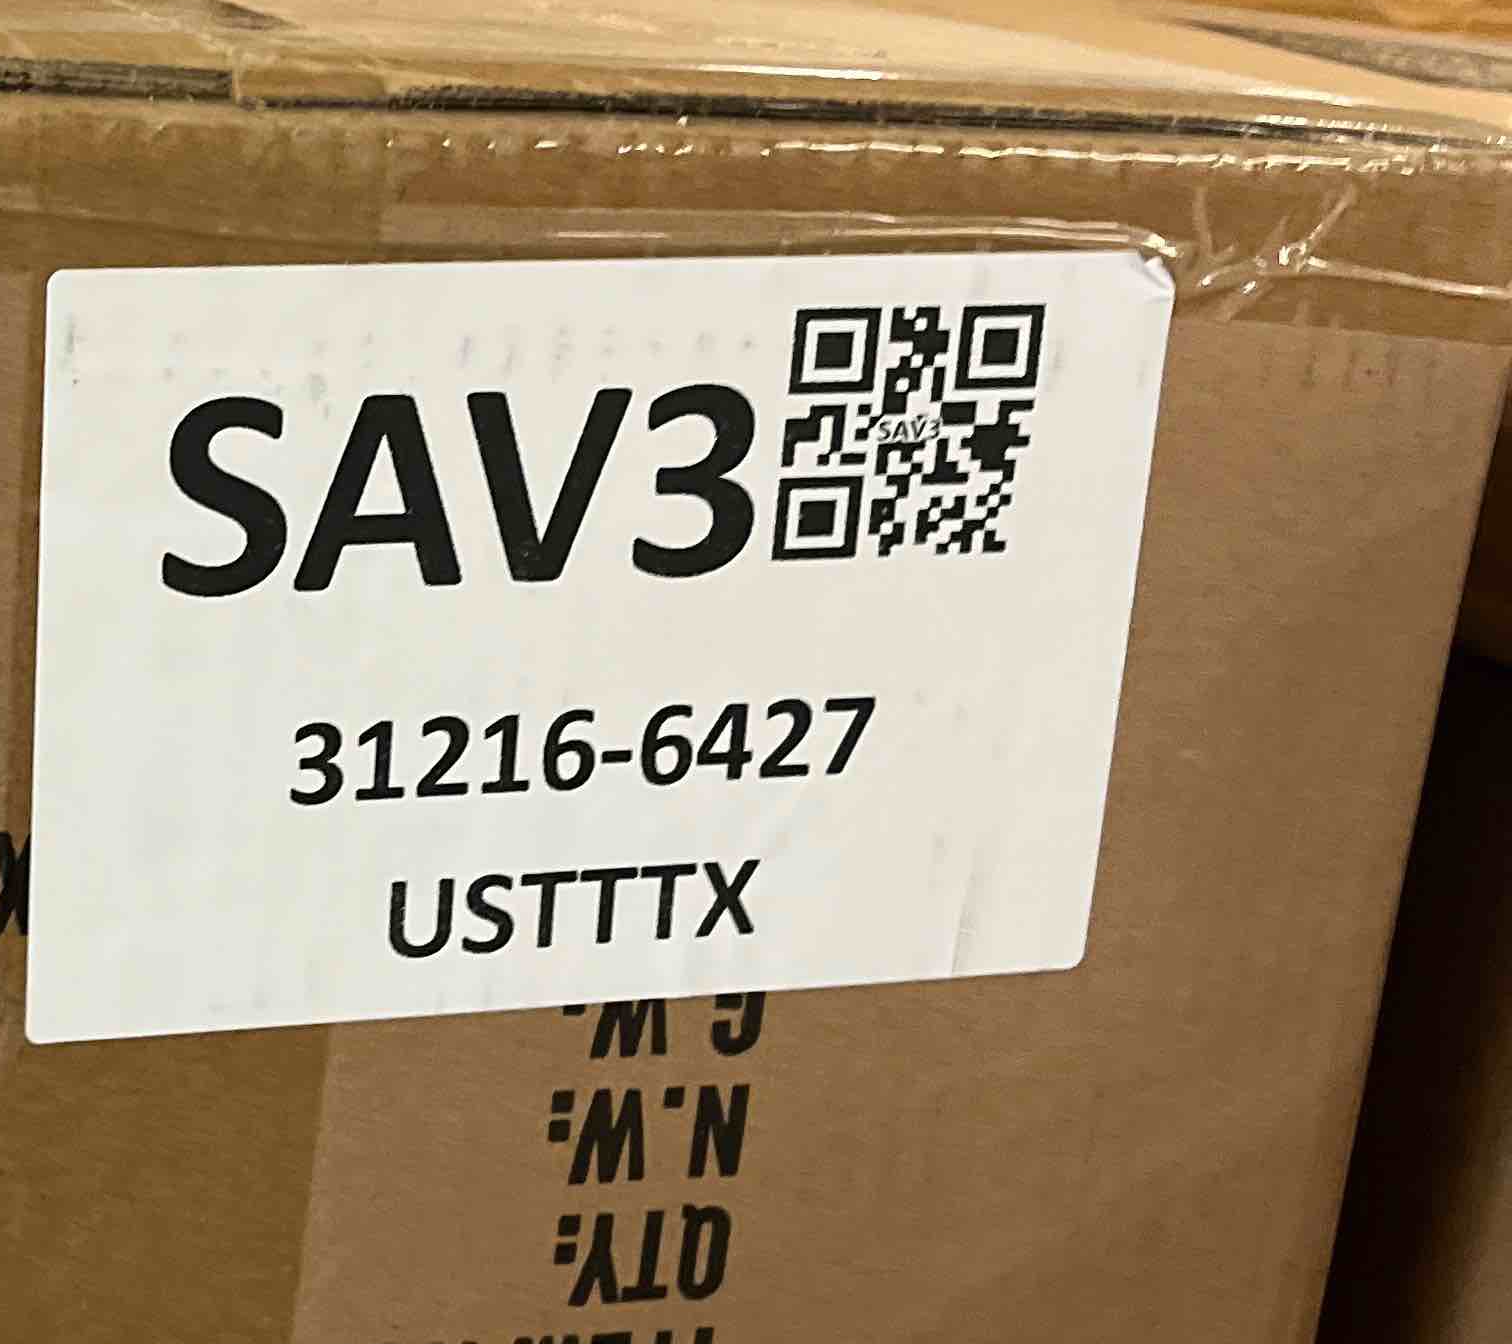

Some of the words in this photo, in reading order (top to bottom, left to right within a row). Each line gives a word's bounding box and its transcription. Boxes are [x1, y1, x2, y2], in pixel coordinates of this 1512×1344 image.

[877, 418, 939, 441] SAV3
[160, 382, 758, 598] SAV3
[289, 694, 876, 808] 31216-6427
[390, 858, 762, 960] USTTTX
[548, 1083, 750, 1186] N.W:
[554, 1203, 732, 1306] QTY:
